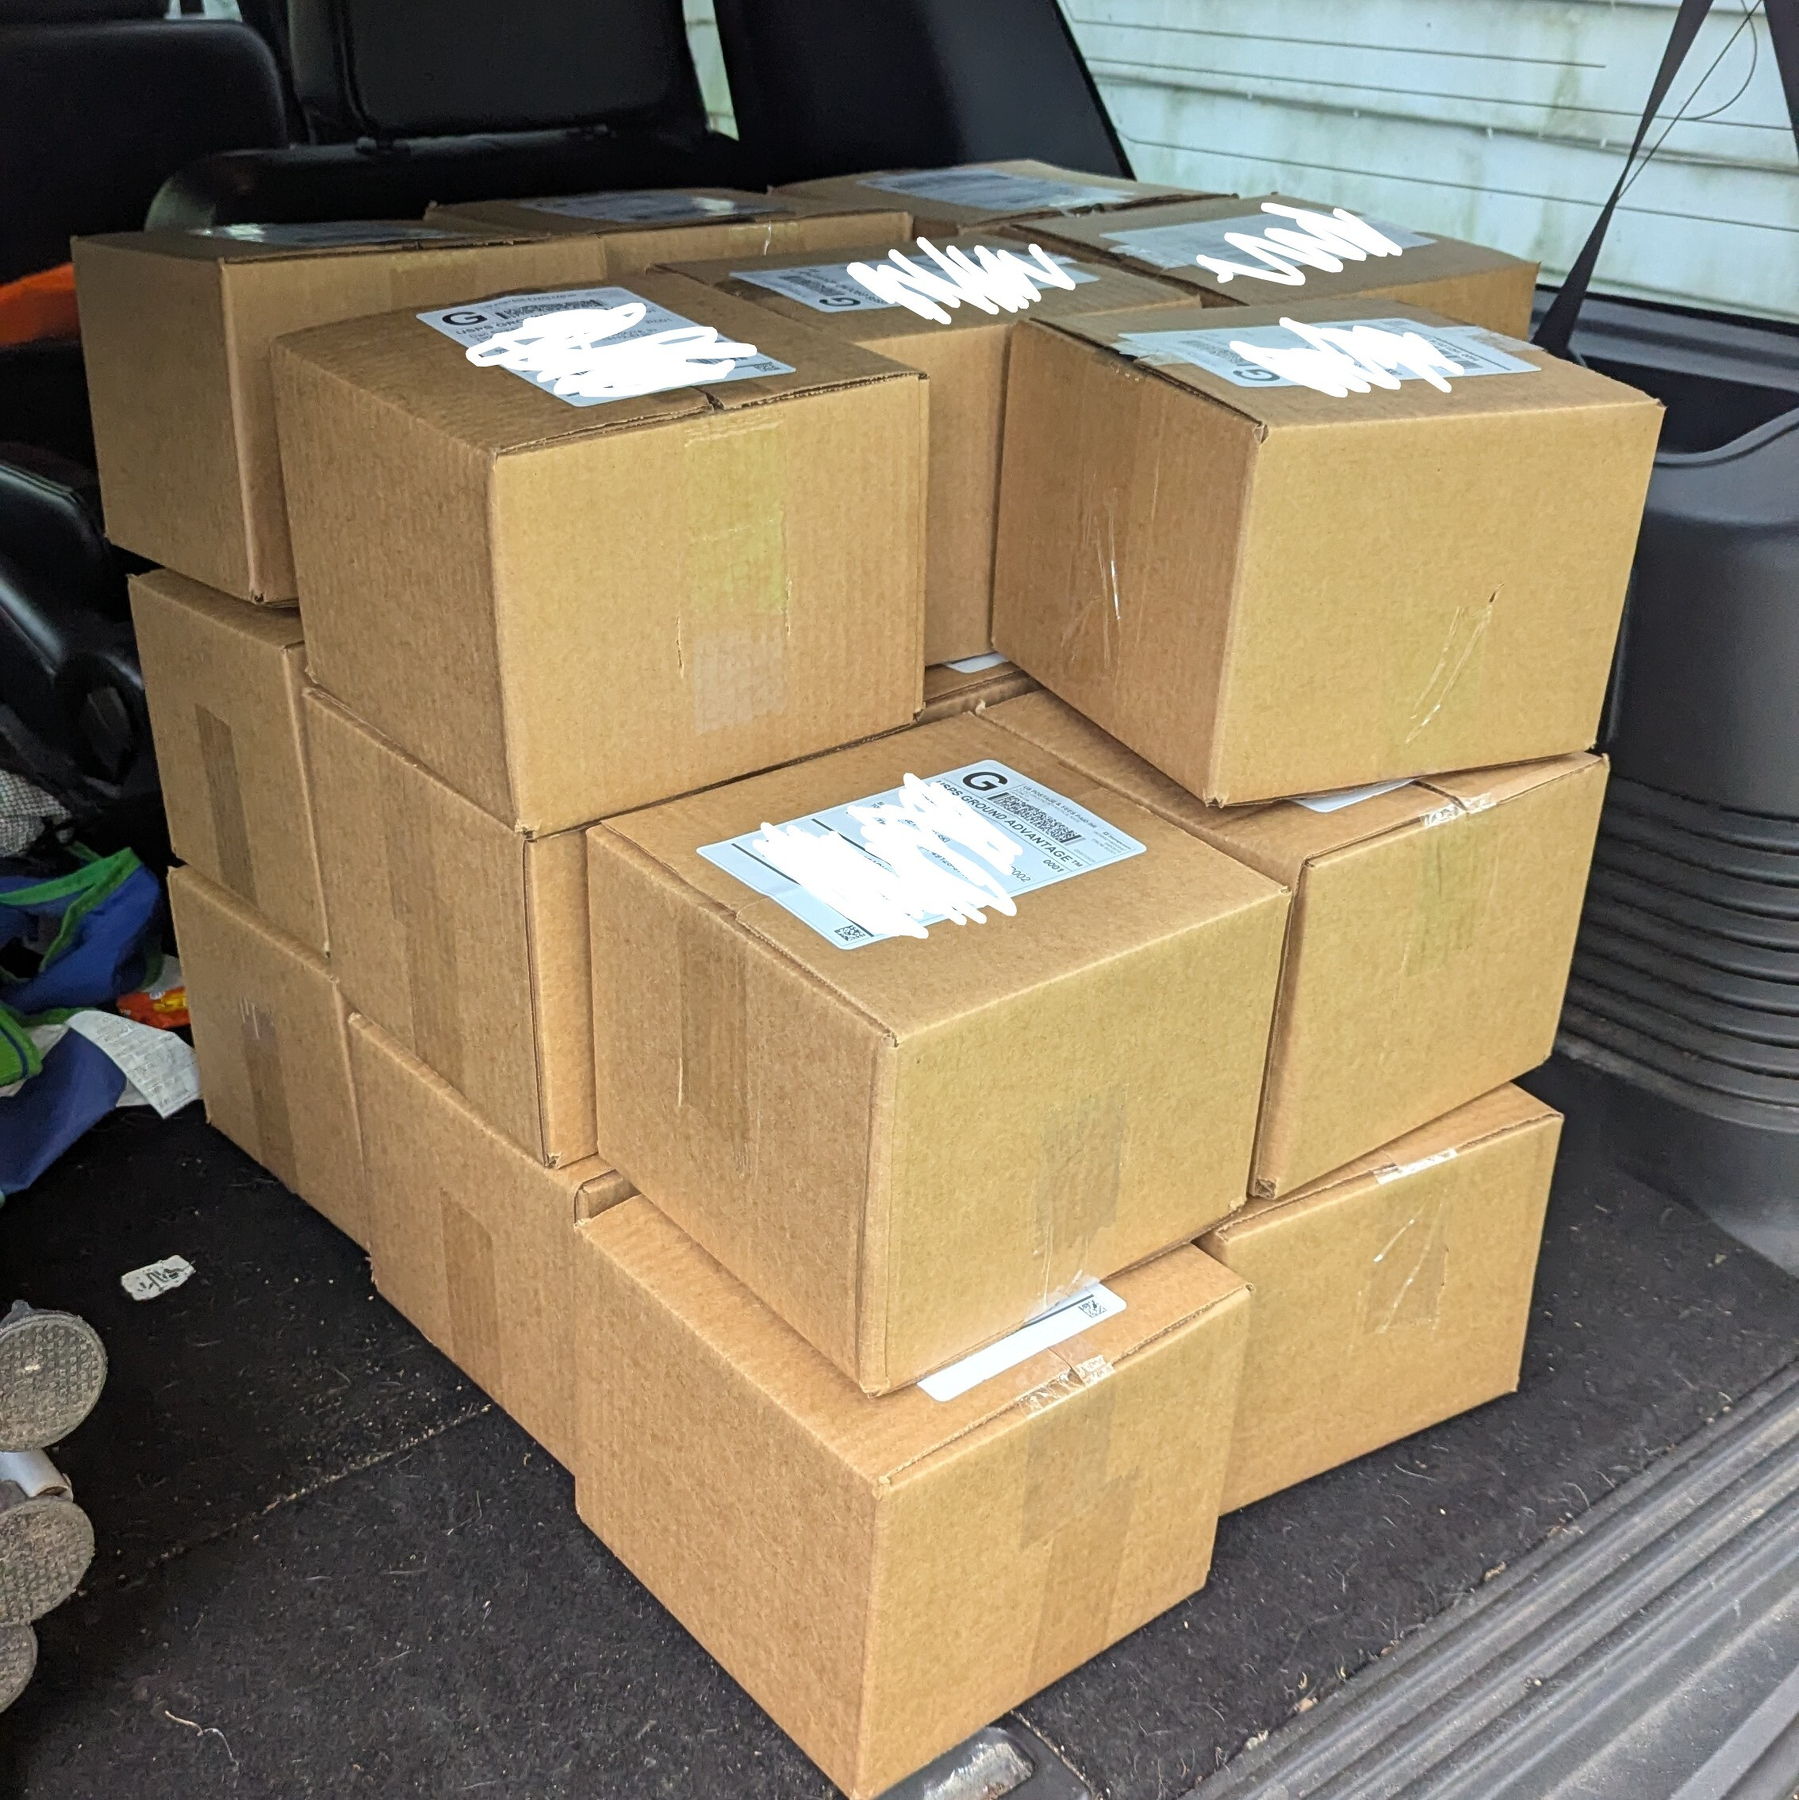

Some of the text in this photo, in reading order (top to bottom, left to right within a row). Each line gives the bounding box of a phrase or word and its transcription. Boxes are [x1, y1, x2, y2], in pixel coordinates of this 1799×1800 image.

[819, 297, 861, 307] G
[442, 311, 488, 326] G
[1232, 368, 1281, 382] G
[962, 771, 1008, 792] G
[961, 795, 1008, 820] GROUND
[1011, 865, 1032, 882] 002
[1043, 859, 1065, 873] 0001
